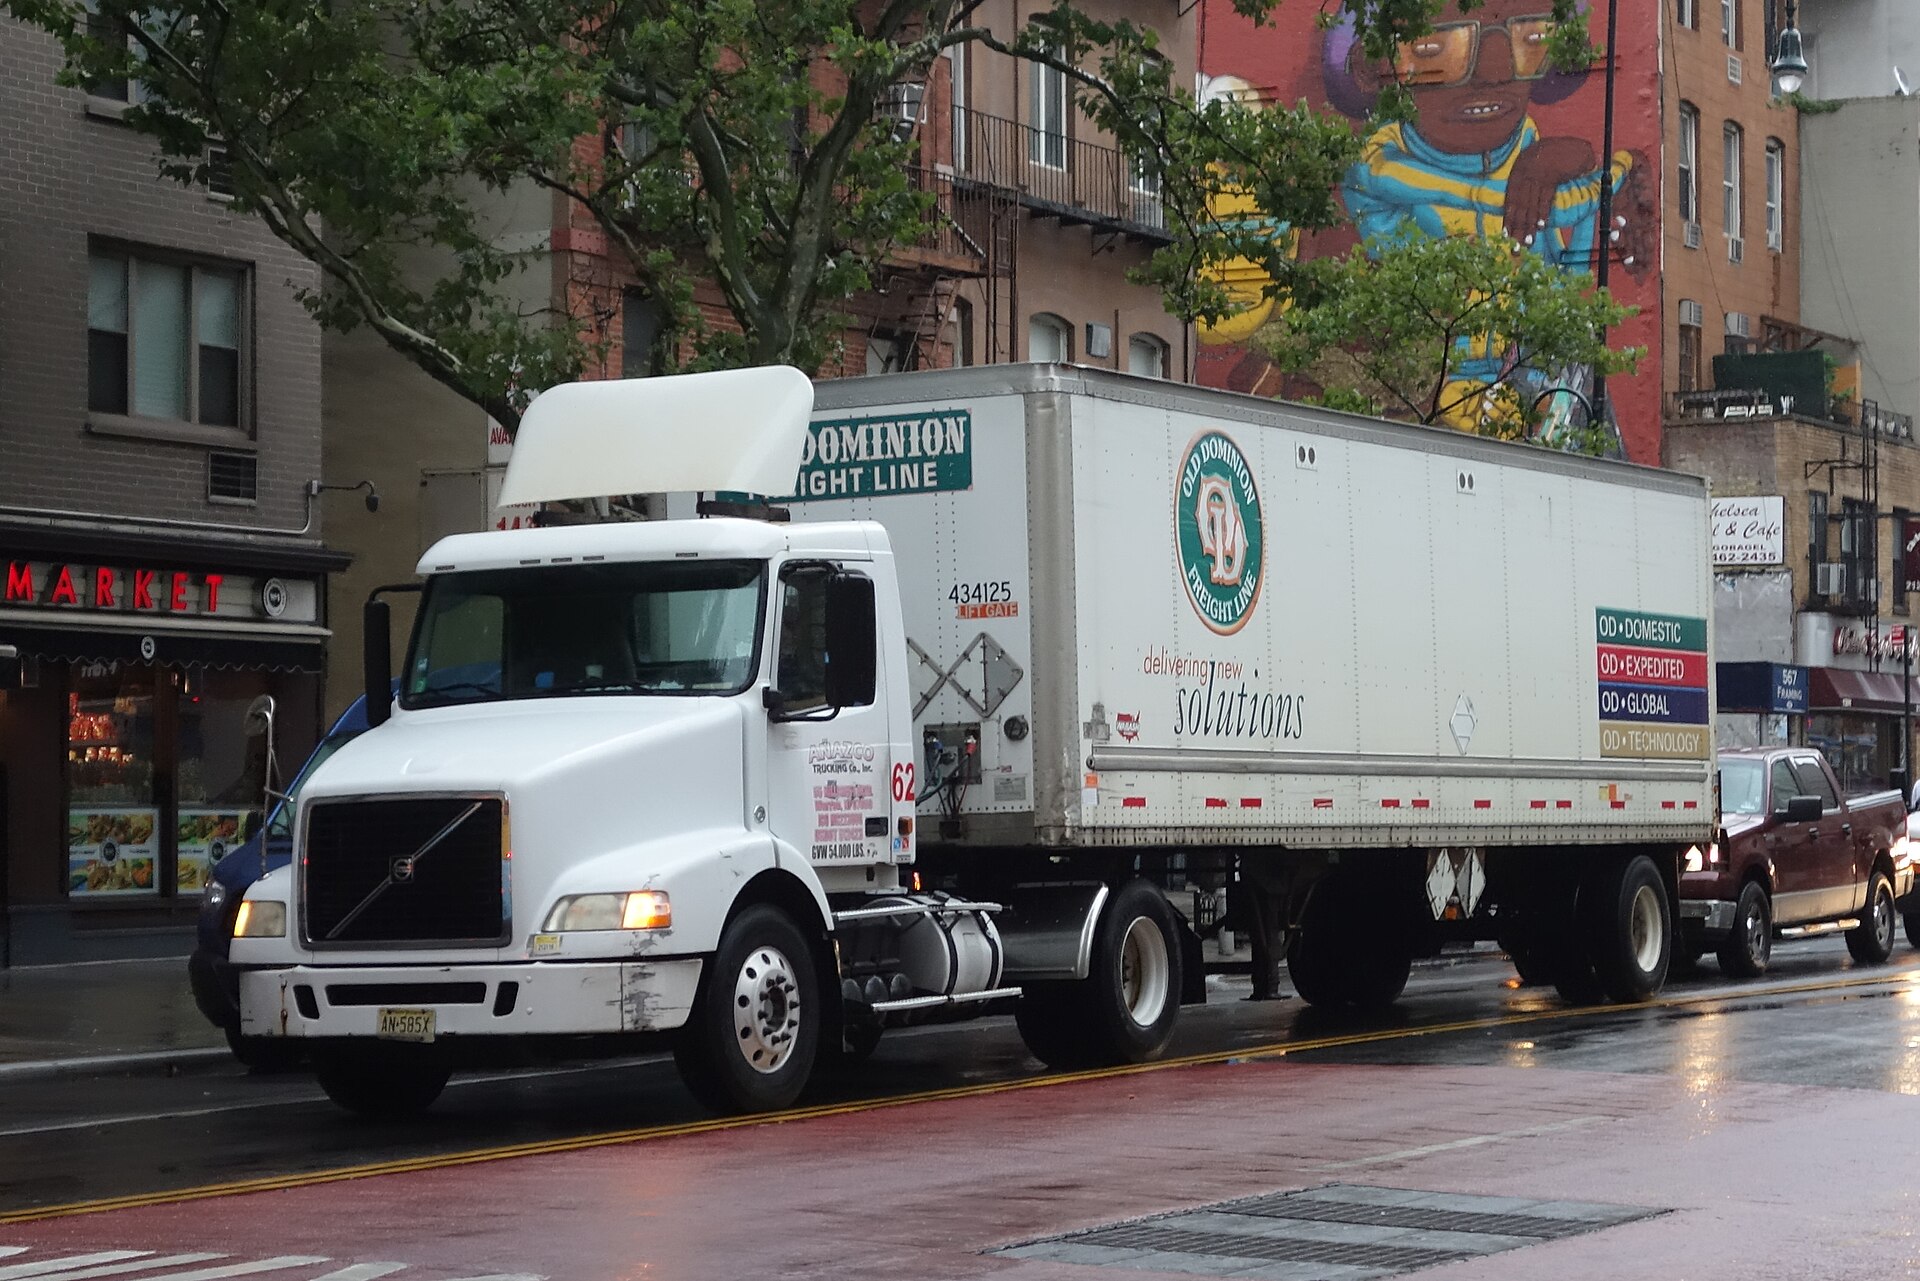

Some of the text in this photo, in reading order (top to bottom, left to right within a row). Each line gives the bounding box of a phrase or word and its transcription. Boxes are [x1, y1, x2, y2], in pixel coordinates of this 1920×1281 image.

[874, 461, 938, 492] LINE
[1182, 436, 1256, 506] OLD DOMINION
[1725, 521, 1737, 536] &
[5, 560, 224, 613] MARKET
[948, 581, 1011, 604] 434125
[1187, 563, 1256, 623] FREIGHT LINE
[956, 602, 1017, 619] LIFT GATE
[1143, 644, 1244, 687] delivering new
[1782, 668, 1798, 686] 567
[1174, 661, 1305, 740] solutions
[812, 763, 848, 775] TRUCKING
[892, 762, 915, 802] 62
[811, 844, 828, 860] GVW
